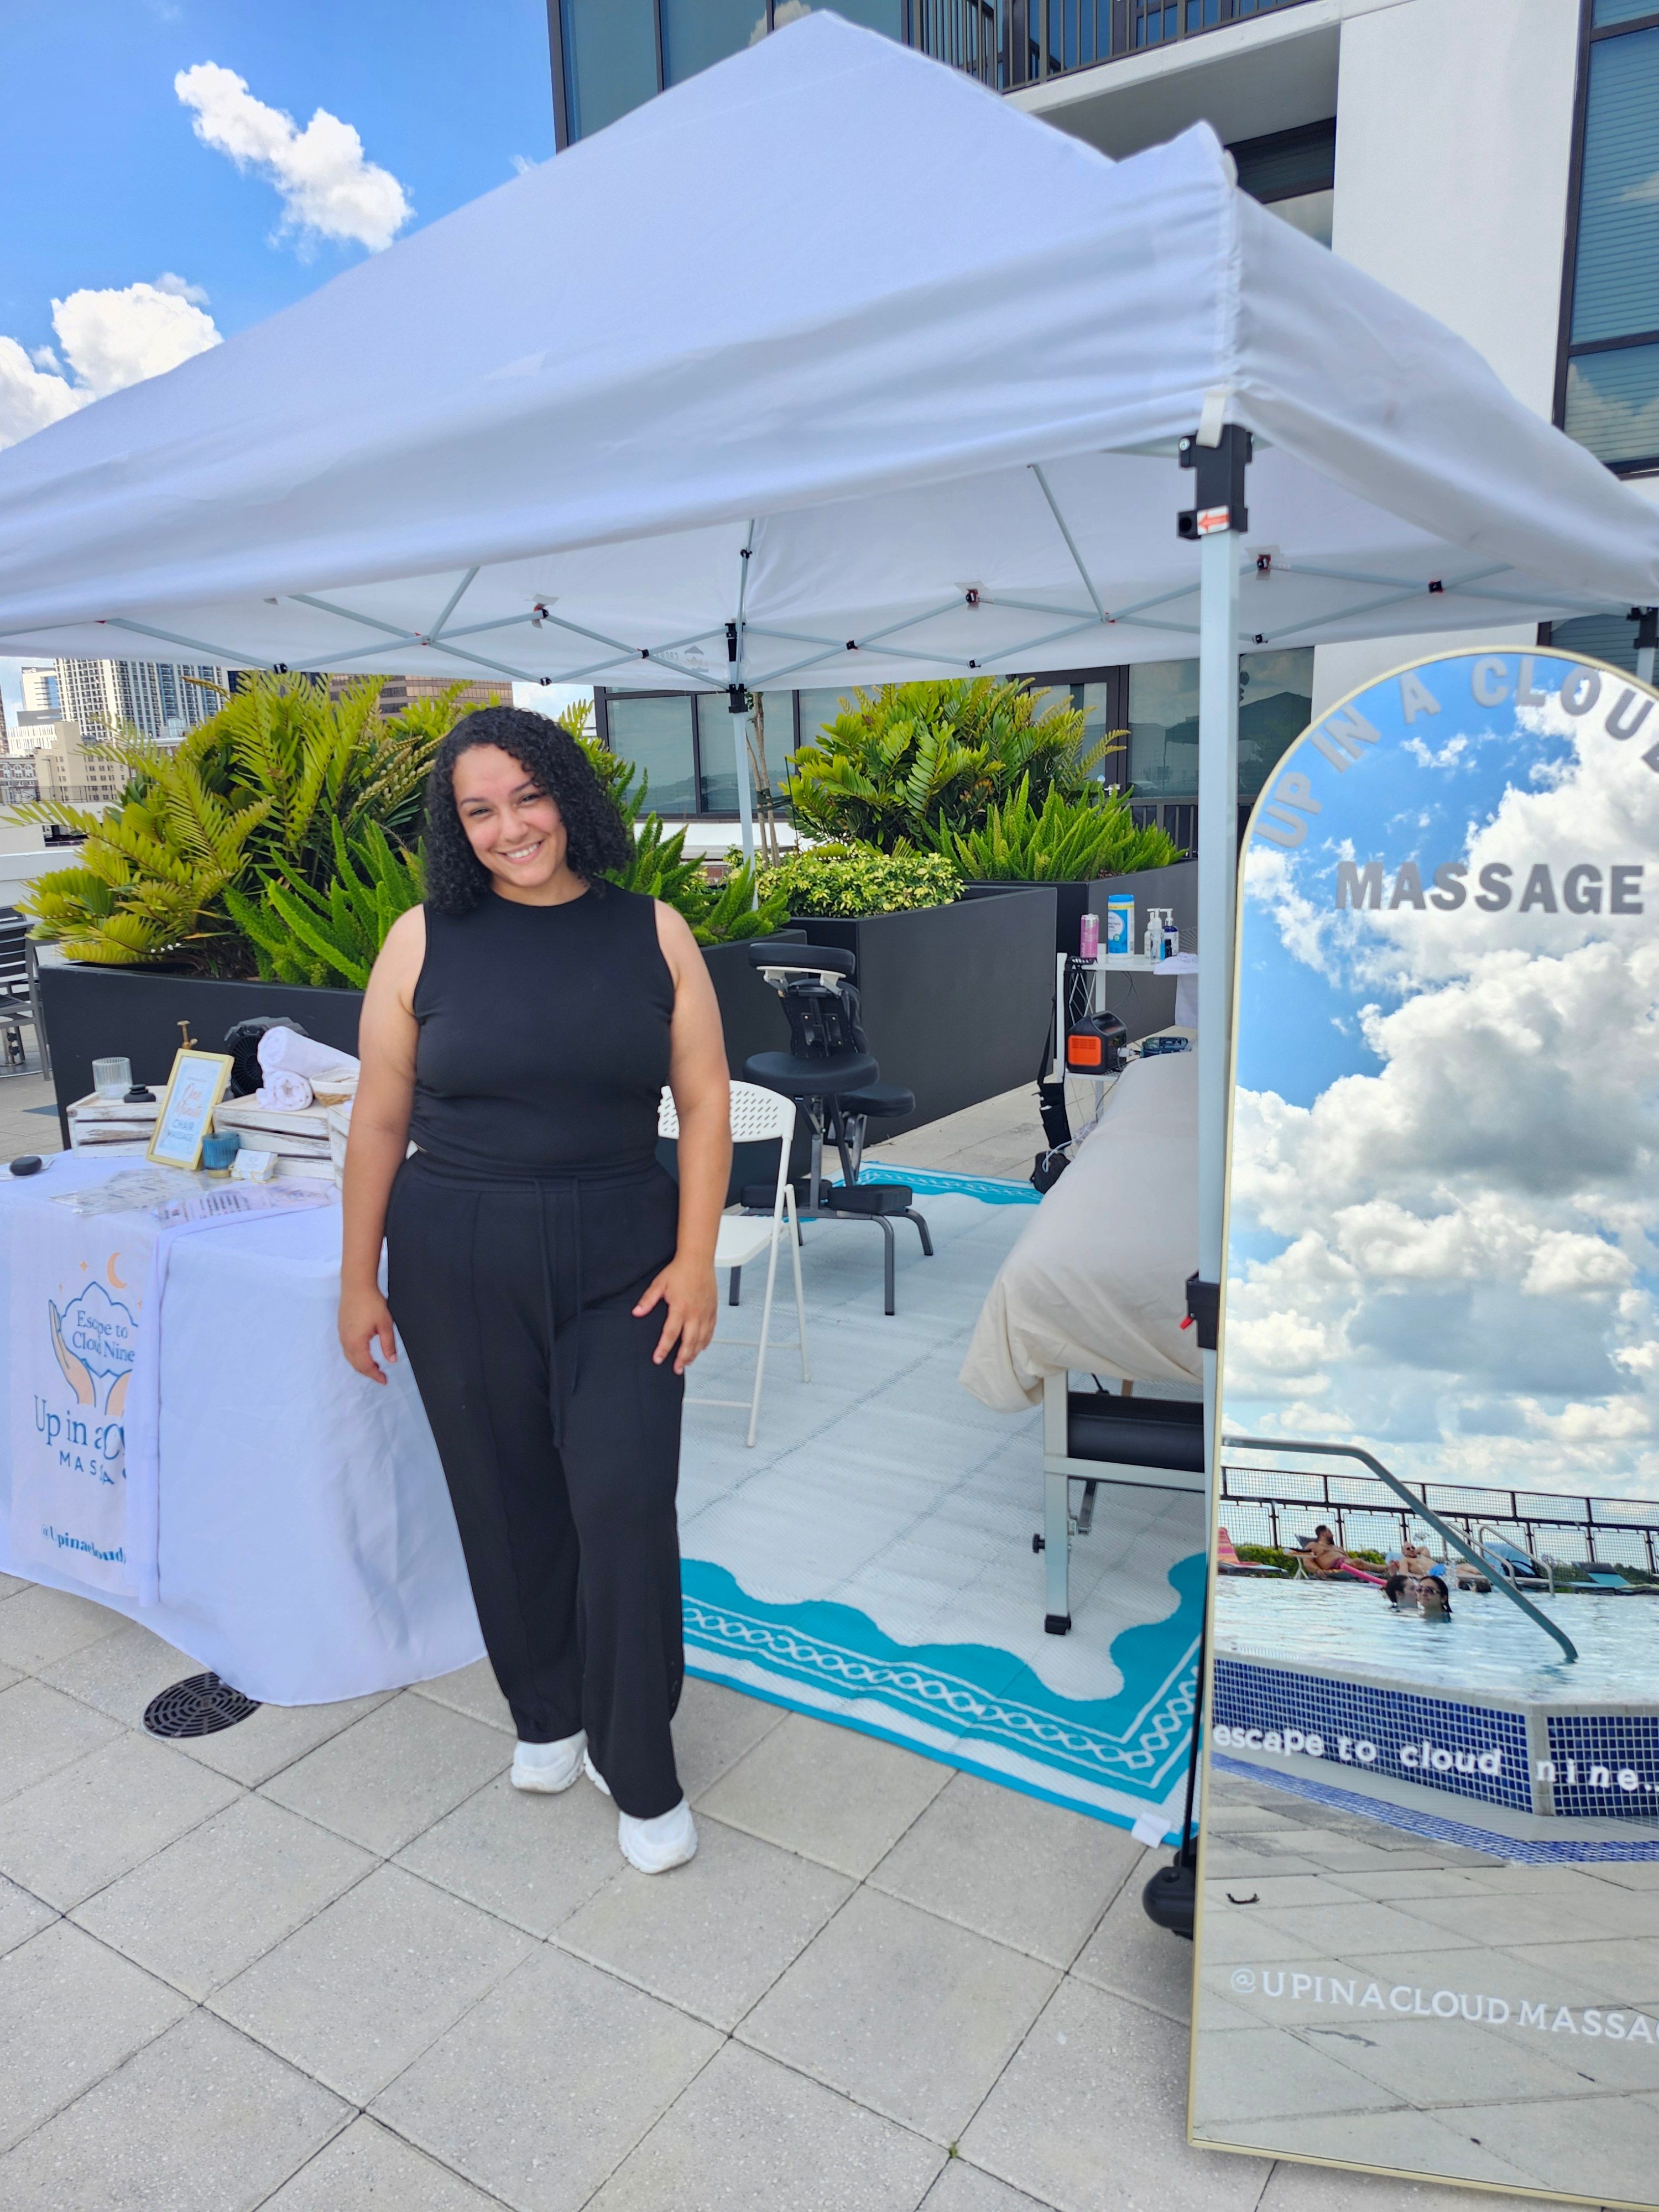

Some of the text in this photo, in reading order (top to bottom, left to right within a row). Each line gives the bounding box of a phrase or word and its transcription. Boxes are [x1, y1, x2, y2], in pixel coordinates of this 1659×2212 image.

[1254, 772, 1322, 848] UP
[1311, 705, 1381, 773] IN
[1398, 672, 1441, 726] A
[1335, 861, 1644, 915] MASSAGE
[103, 1340, 135, 1363] Nine
[116, 1325, 128, 1338] to
[34, 1395, 61, 1446] Up
[66, 1410, 88, 1446] in
[1213, 1724, 1324, 1757] escape
[1337, 1735, 1377, 1762] to
[1400, 1741, 1503, 1776] cloud
